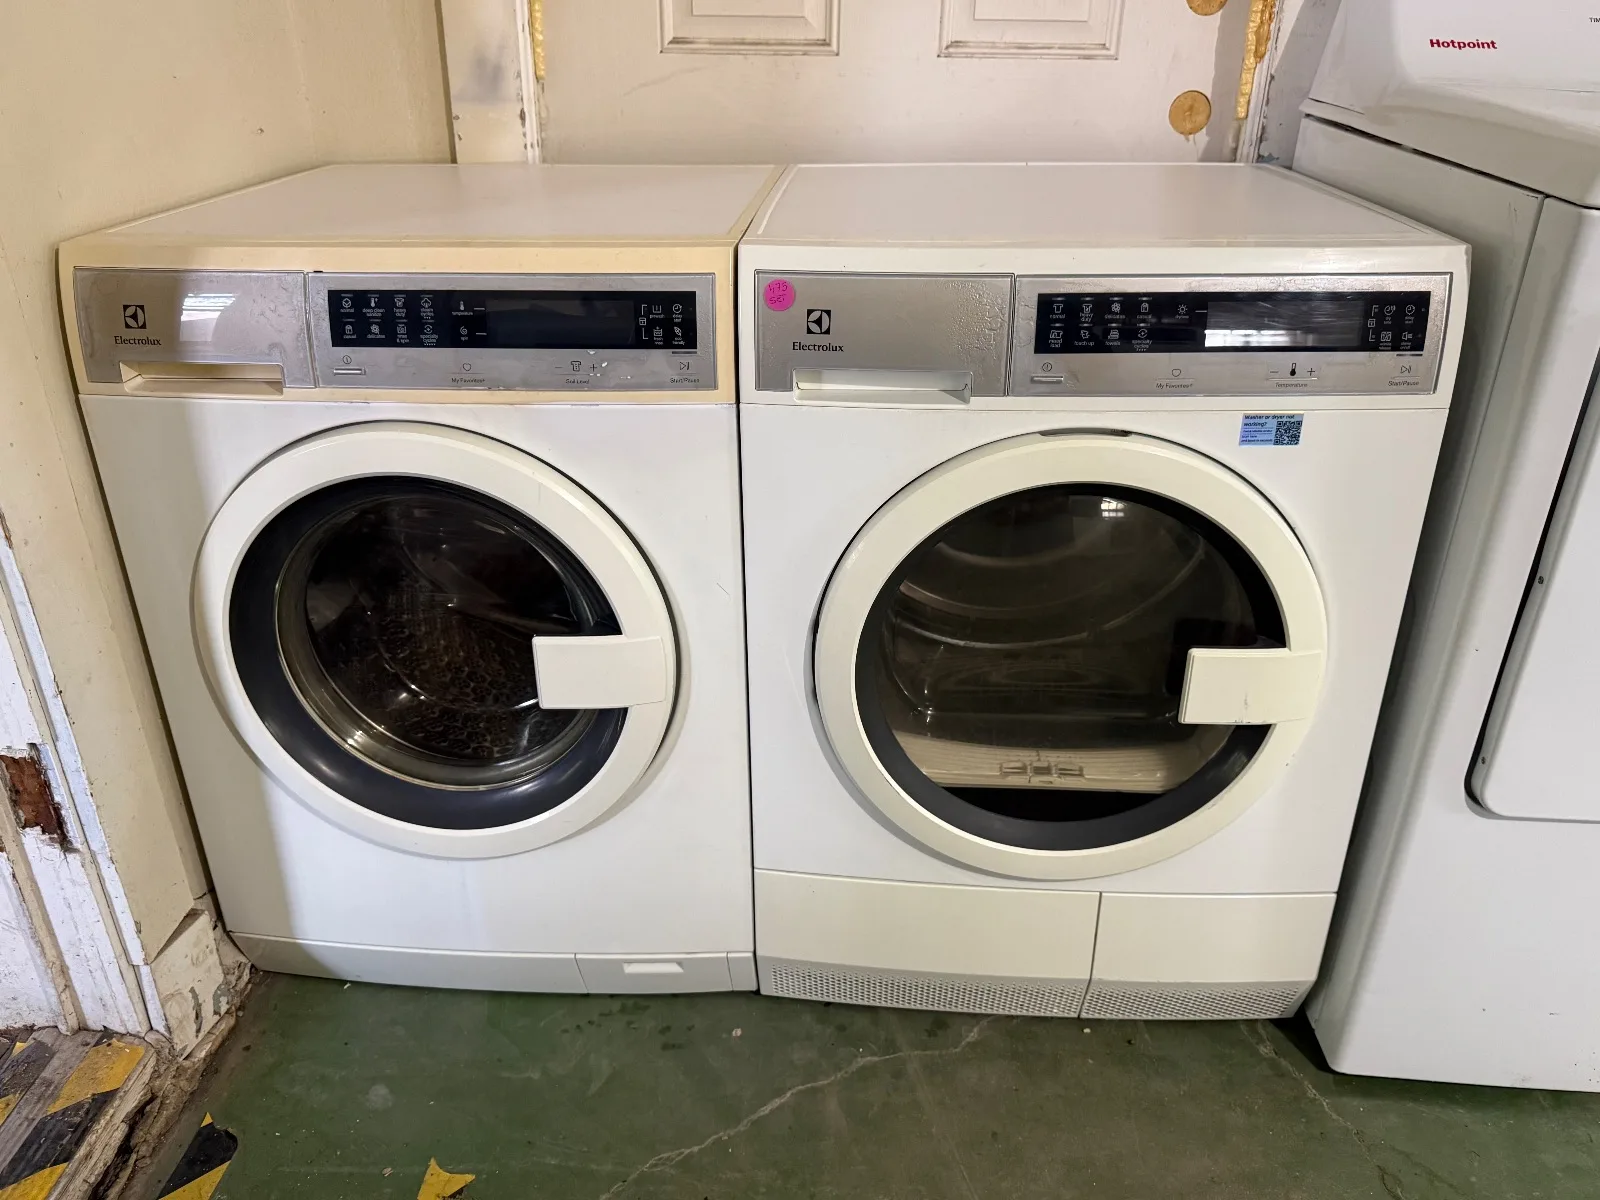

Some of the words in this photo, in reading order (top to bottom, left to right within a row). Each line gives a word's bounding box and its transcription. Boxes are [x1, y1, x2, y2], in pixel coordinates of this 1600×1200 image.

[1430, 39, 1497, 50] Hotpoint
[114, 336, 162, 345] Electrolux
[792, 342, 844, 352] Electrolux
